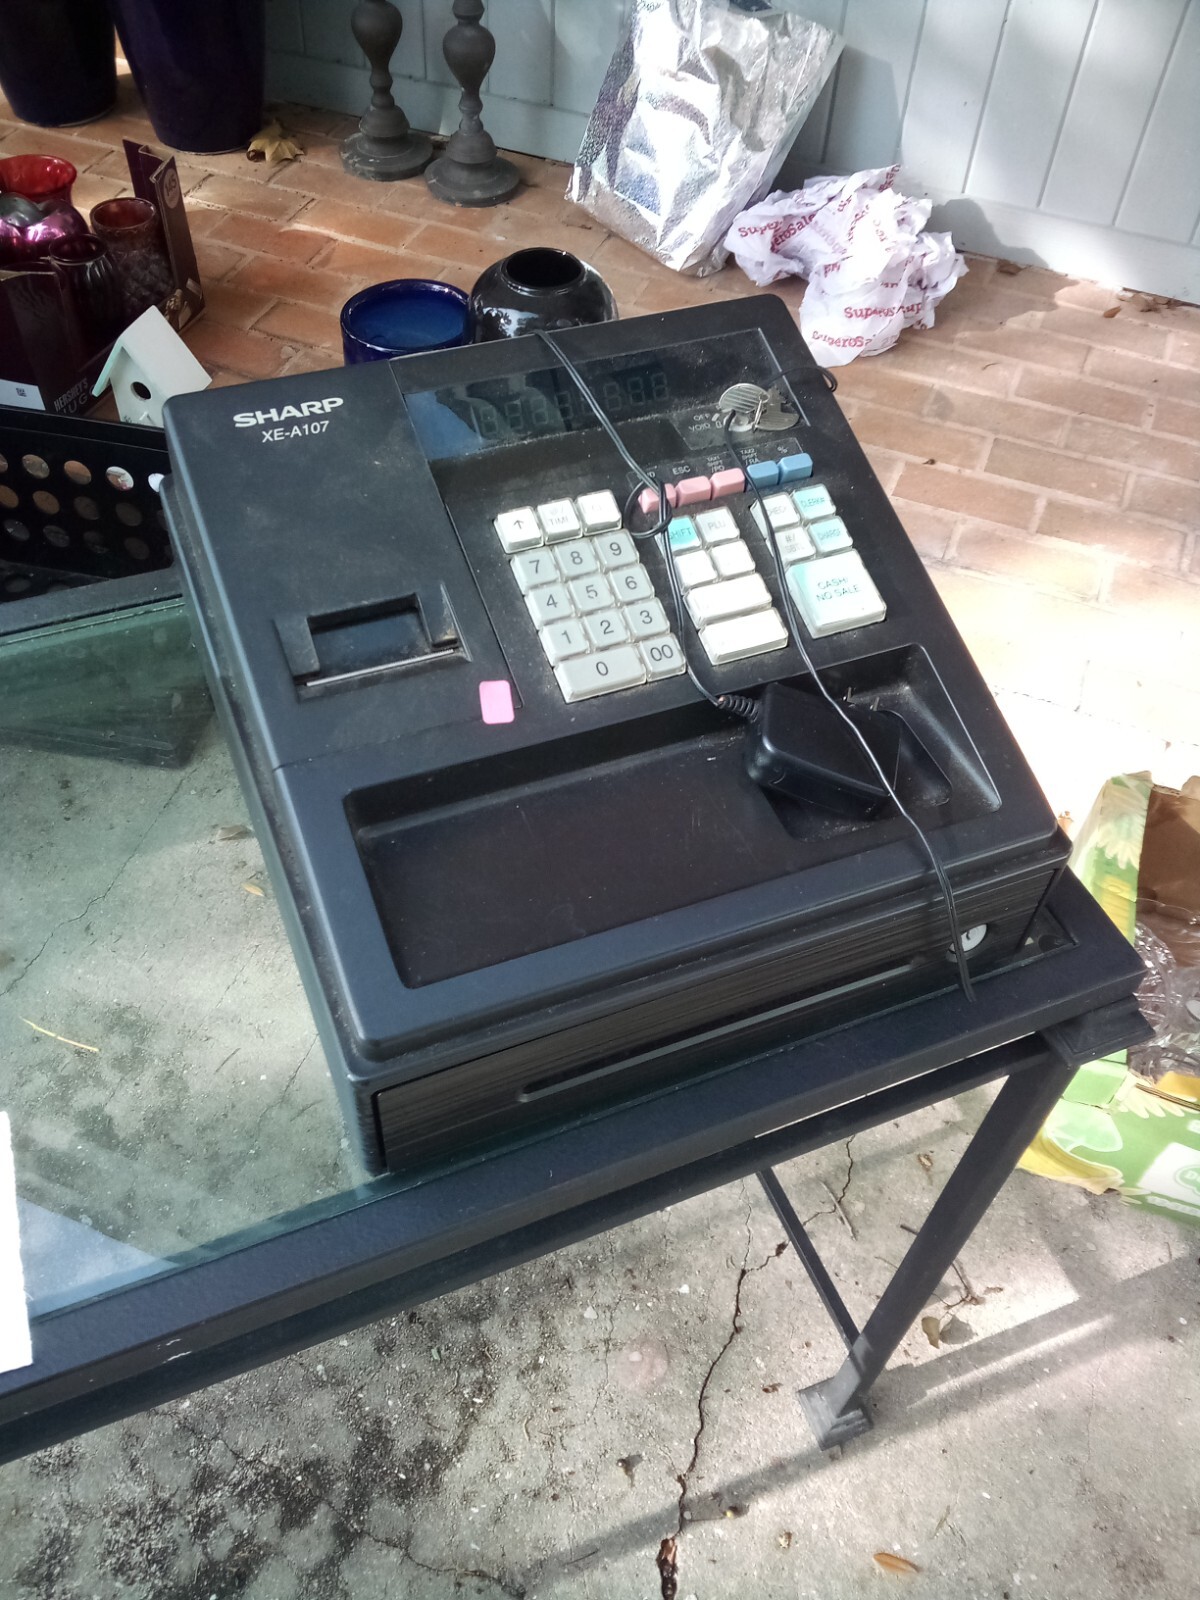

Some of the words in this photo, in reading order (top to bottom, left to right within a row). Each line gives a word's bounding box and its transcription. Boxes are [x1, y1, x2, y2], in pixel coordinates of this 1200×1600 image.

[233, 397, 344, 427] SHARP
[261, 420, 330, 443] XE-A107
[672, 465, 691, 476] ESC
[609, 542, 622, 557] 9
[570, 551, 583, 565] 8
[529, 559, 541, 574] 7
[625, 576, 638, 590] 6
[585, 584, 598, 600] 5
[546, 594, 558, 608] 4
[639, 610, 653, 625] 3
[600, 620, 614, 635] 2
[561, 630, 572, 645] 1
[650, 644, 674, 662] 00
[595, 661, 609, 676] 0
